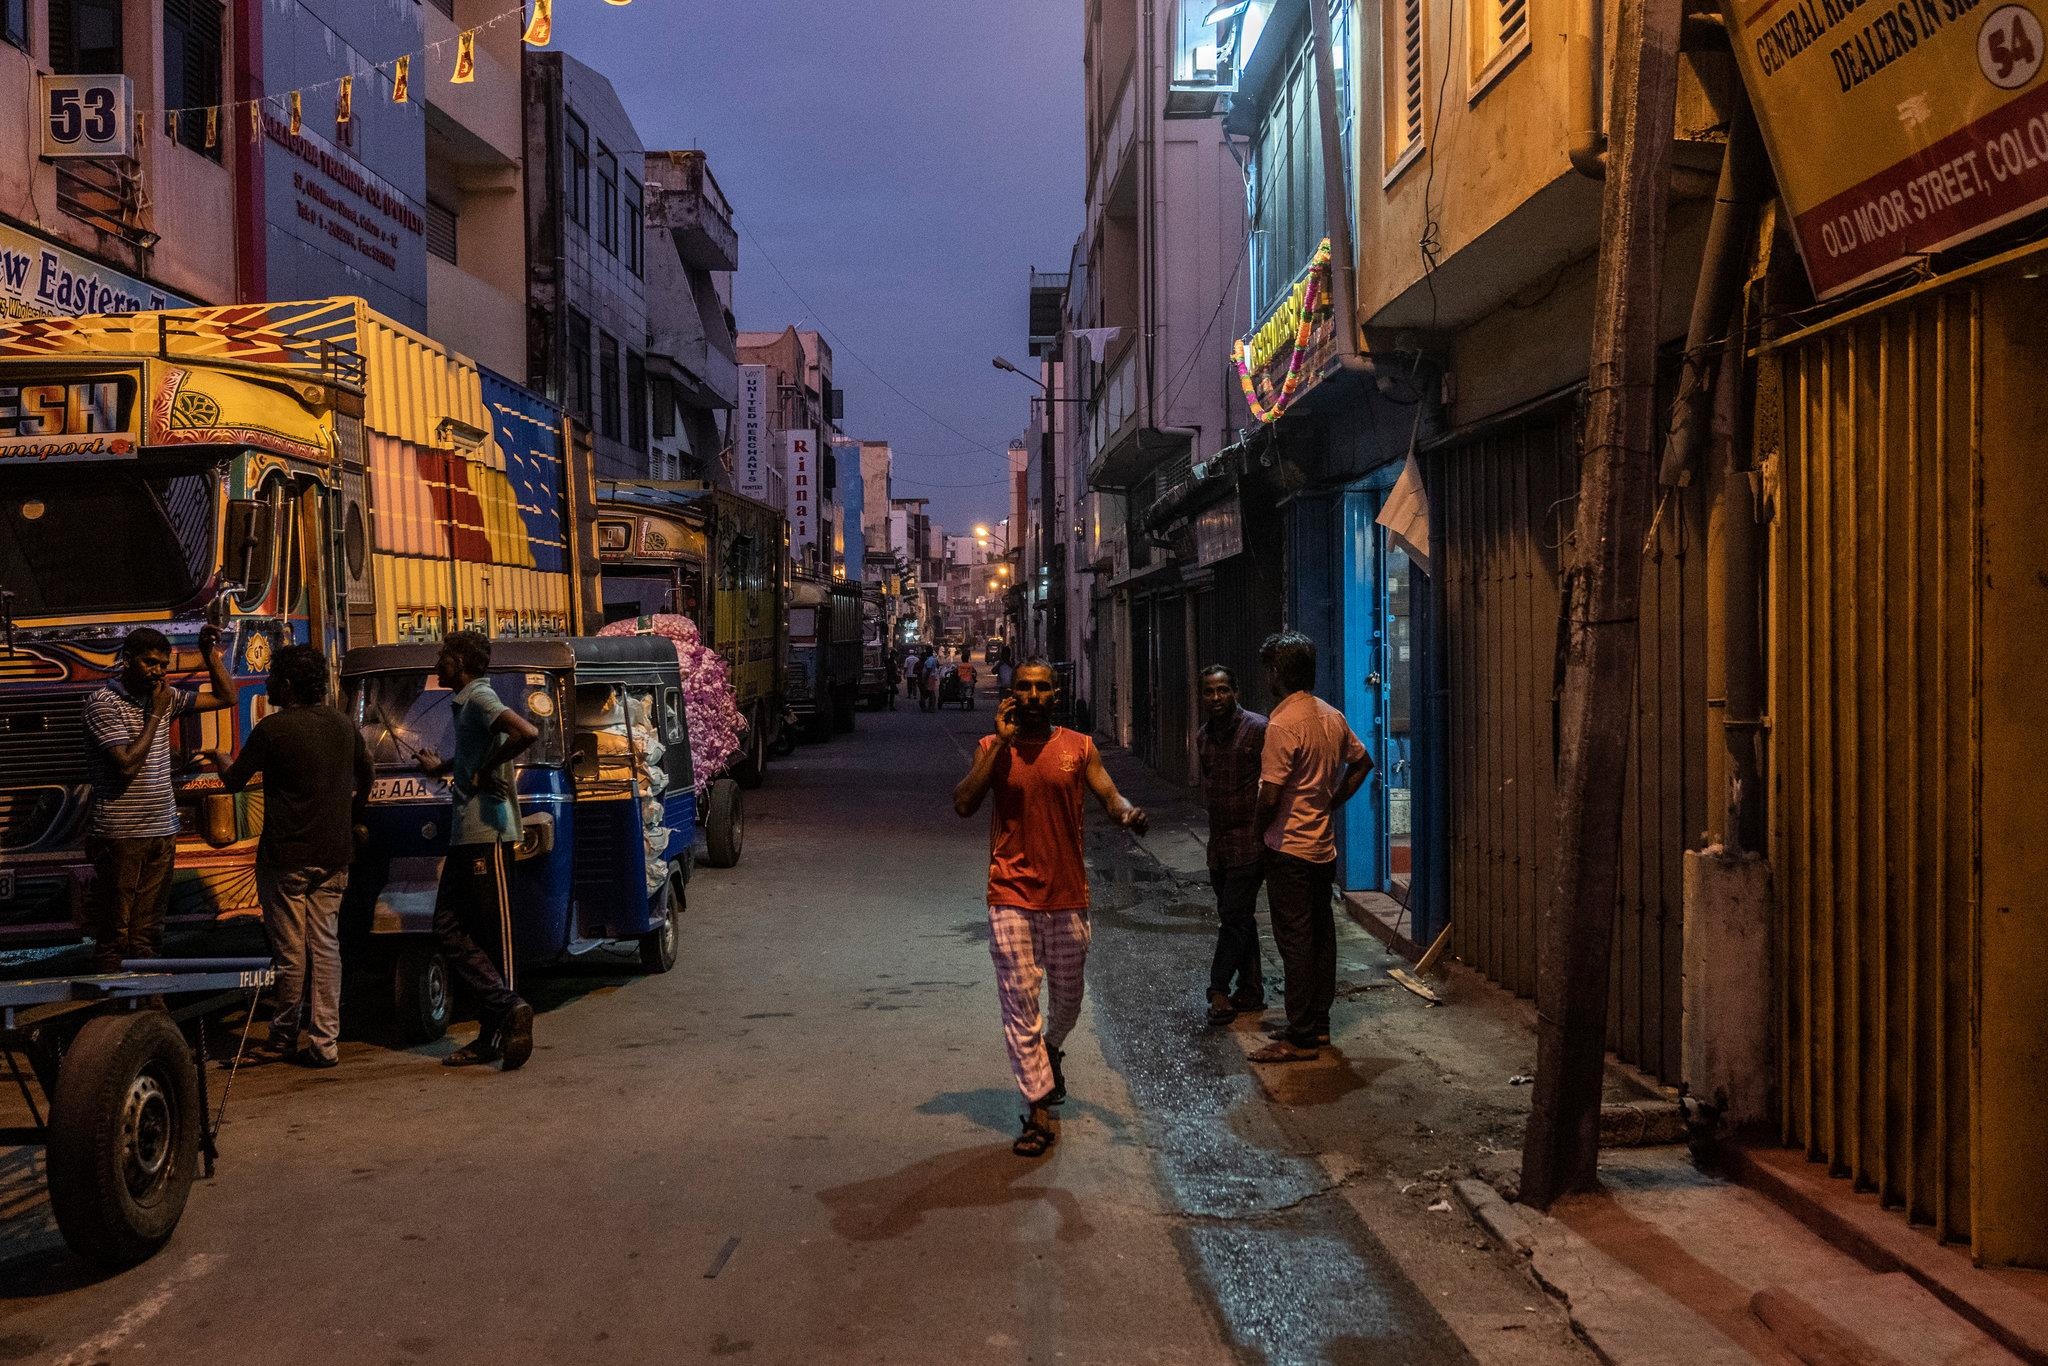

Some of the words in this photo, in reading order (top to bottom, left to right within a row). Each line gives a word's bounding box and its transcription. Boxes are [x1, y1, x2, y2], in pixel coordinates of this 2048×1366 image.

[1756, 0, 1826, 77] GENERAL
[1830, 2, 1918, 93] DEALERS
[1911, 0, 1942, 39] IN
[1987, 14, 2034, 79] 5A
[50, 87, 116, 143] 53
[1821, 215, 1857, 258] OLD
[1853, 189, 1912, 244] MOOR
[1907, 150, 1991, 220] STREET,
[0, 250, 30, 289] w
[747, 379, 757, 419] UNITED
[746, 423, 758, 482] MERCHANTS
[793, 440, 809, 536] Rinnai
[389, 780, 428, 798] AAA
